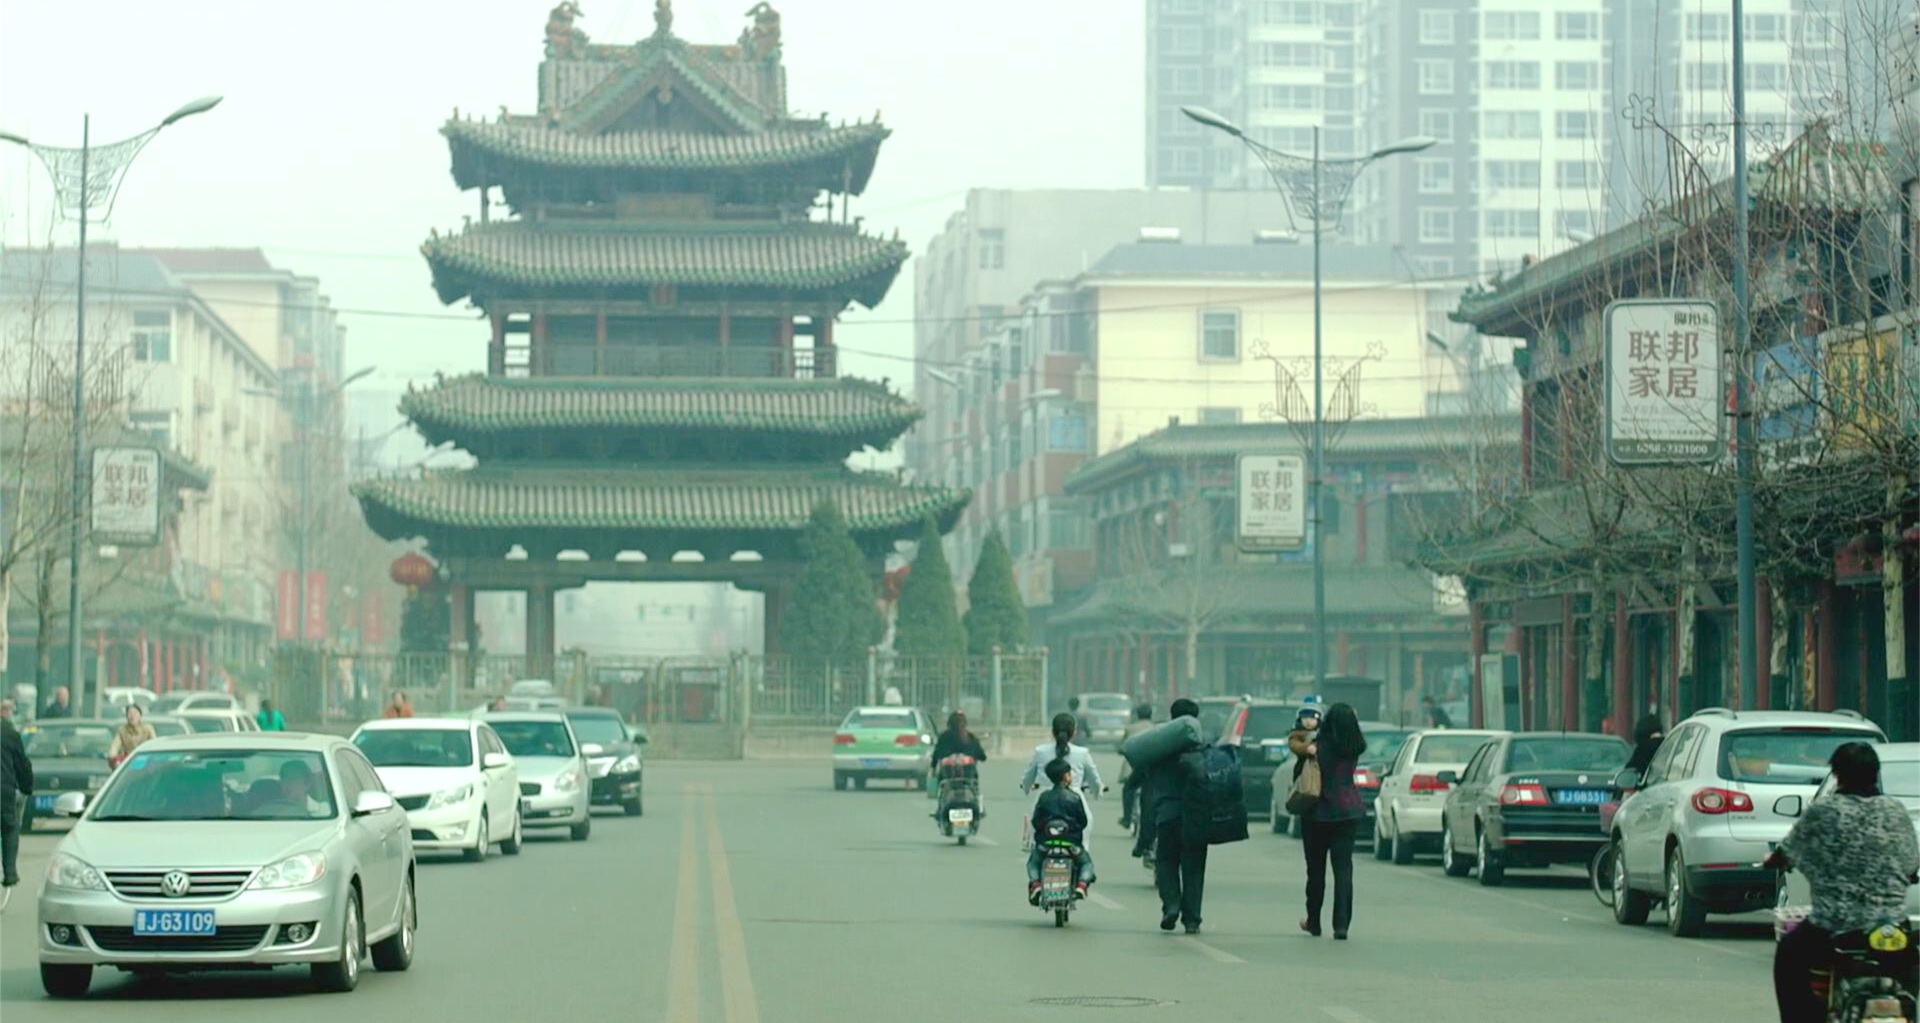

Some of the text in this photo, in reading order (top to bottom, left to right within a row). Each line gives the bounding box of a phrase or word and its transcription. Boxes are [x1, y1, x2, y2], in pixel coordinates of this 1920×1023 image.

[1628, 330, 1699, 363] 联邦
[1628, 366, 1698, 398] 家居
[1250, 470, 1293, 490] 联邦
[1250, 492, 1293, 512] 家居
[137, 911, 214, 931] J·G3109
